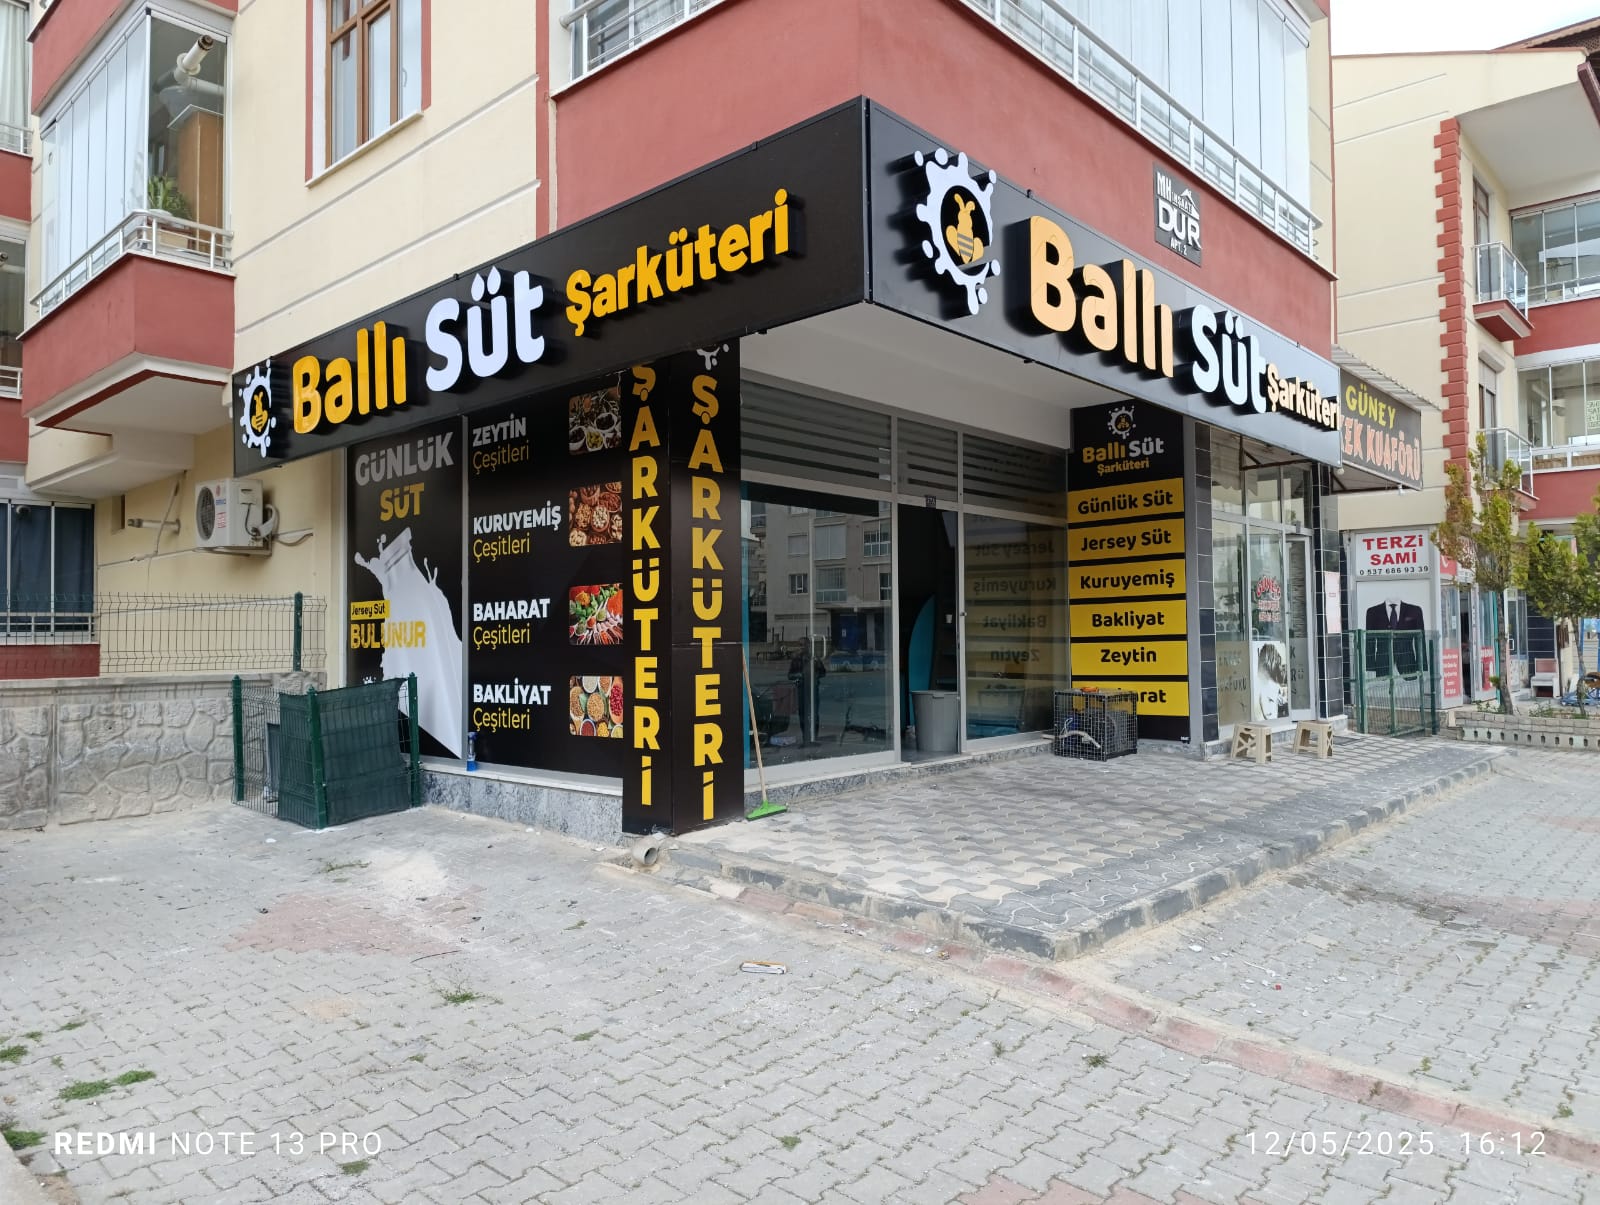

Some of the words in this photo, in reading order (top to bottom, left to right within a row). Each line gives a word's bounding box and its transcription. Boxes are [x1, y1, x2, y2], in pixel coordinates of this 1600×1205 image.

[1157, 171, 1172, 202] MH
[1158, 198, 1202, 249] DUR
[292, 320, 407, 435] Ballı
[426, 266, 545, 392] Süt
[566, 188, 788, 336] Şarküteri
[1030, 215, 1173, 378] Ballı
[1191, 304, 1267, 413] Süt
[1345, 384, 1396, 429] GÜNEY
[472, 413, 527, 447] ZEYTİN
[355, 432, 454, 486] GÜNLÜK
[473, 440, 529, 474] Çeşitleri
[1082, 441, 1126, 463] Ballı
[1129, 437, 1164, 457] Süt
[1366, 424, 1421, 481] KUAFÖRÜ
[1097, 457, 1149, 476] Şarküteri
[380, 482, 424, 521] SÜT
[1078, 493, 1138, 514] Günlük
[1143, 490, 1173, 508] Süt
[473, 500, 561, 535] KURUYEMİŞ
[473, 532, 530, 563] Çeşitleri
[1081, 535, 1136, 551] Jersey
[1141, 528, 1171, 546] Süt
[1367, 568, 1382, 576] 537
[1404, 566, 1415, 574] 93
[1417, 565, 1429, 573] 39
[1370, 549, 1417, 566] SAMİ
[629, 366, 661, 806] ŞARKÜTERİ
[1080, 569, 1174, 591] Kuruyemiş
[351, 604, 373, 617] Jersey
[374, 602, 385, 614] Süt
[473, 598, 550, 621] BAHARAT
[687, 375, 723, 820] ŞARKÜTERİ
[1092, 610, 1164, 629] Bakliyat
[350, 621, 426, 649] BULUNUR
[473, 623, 530, 650] Çeşitleri
[1100, 647, 1157, 666] Zeytin
[473, 677, 551, 705] BAKLİYAT
[473, 707, 530, 732] Çeşitleri
